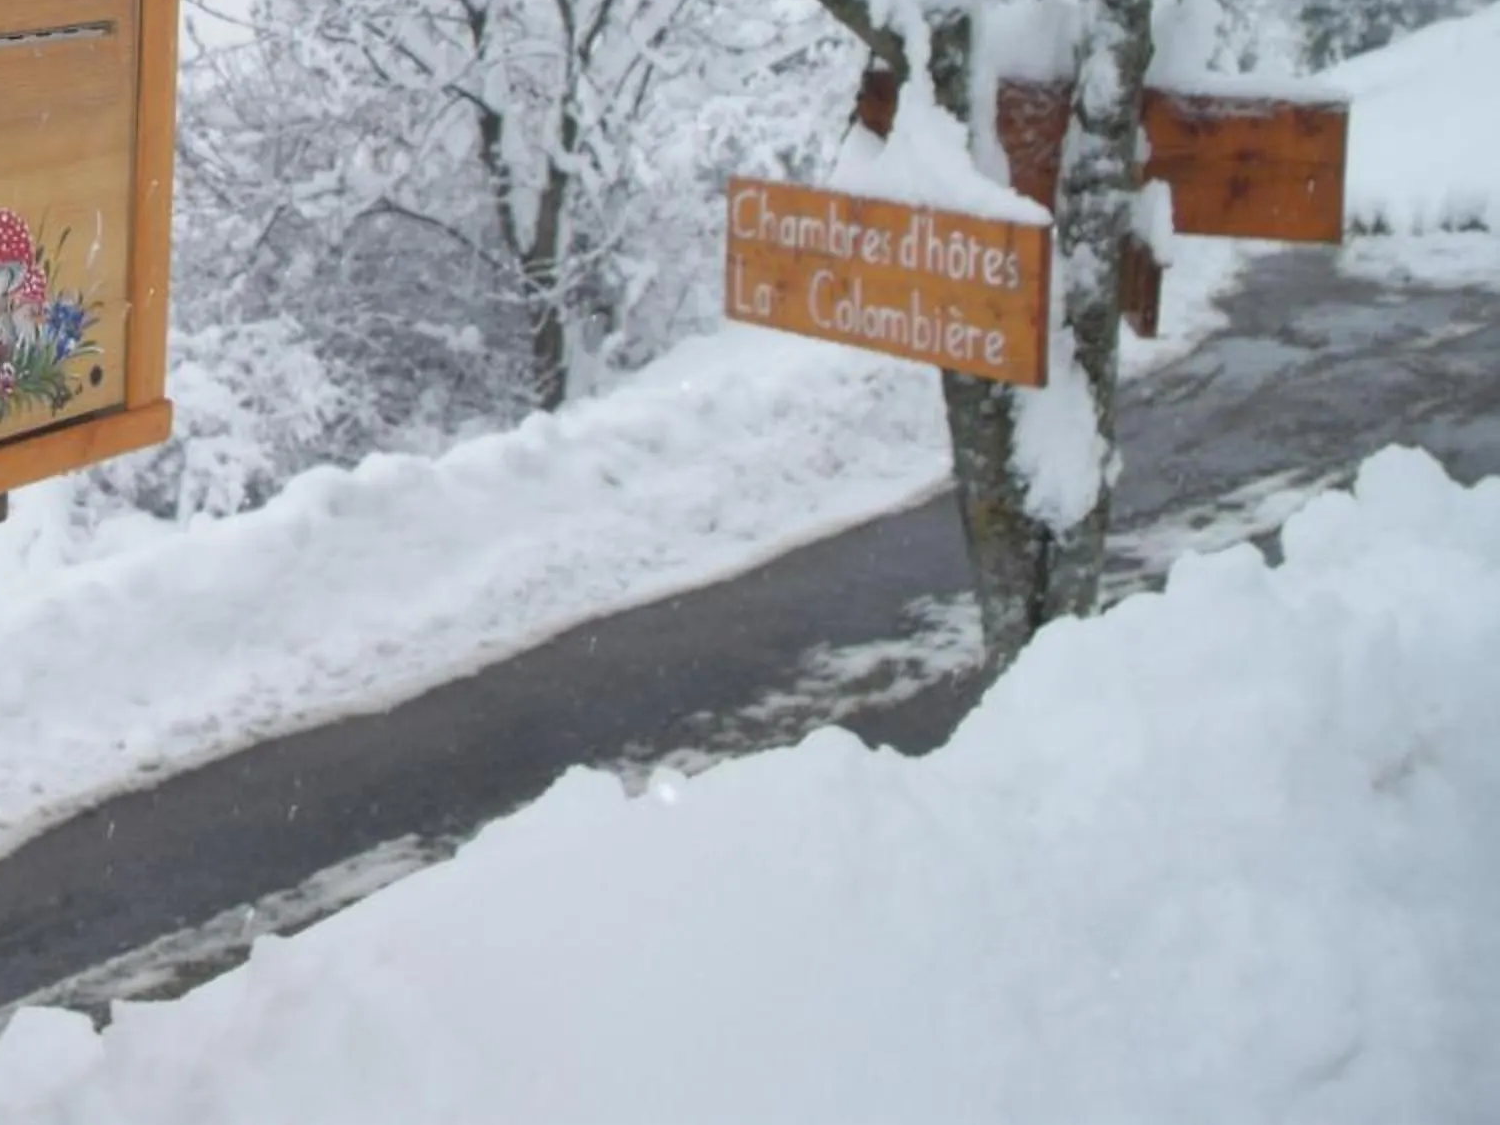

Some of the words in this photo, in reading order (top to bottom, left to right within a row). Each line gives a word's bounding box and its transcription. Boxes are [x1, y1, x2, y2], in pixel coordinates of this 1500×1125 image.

[731, 190, 892, 264] Chambres
[900, 212, 1018, 288] d'hôtes
[733, 255, 773, 317] La
[808, 270, 1005, 364] Colombière
